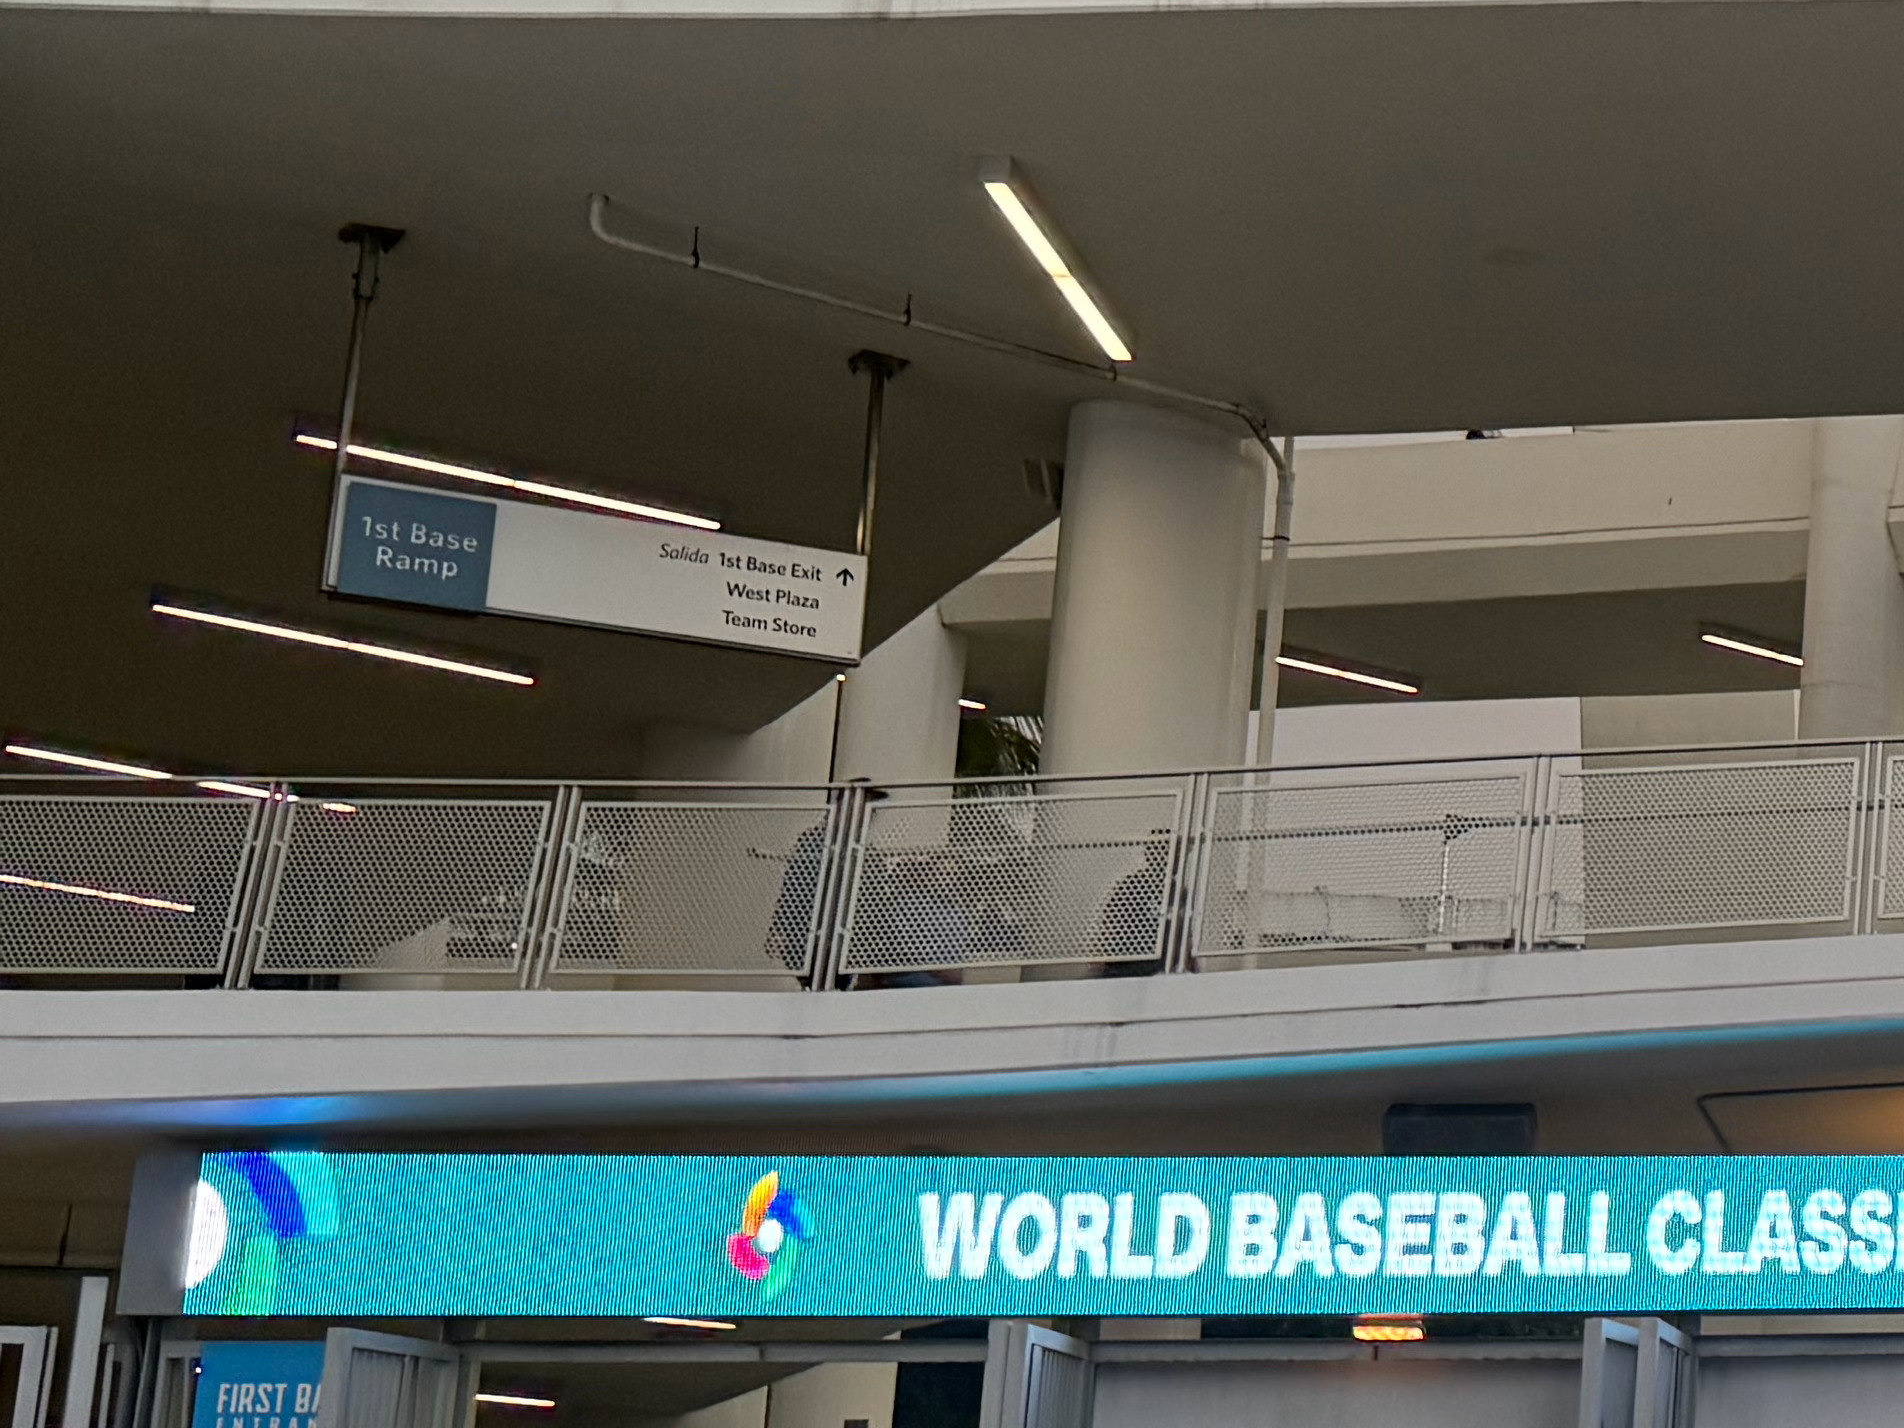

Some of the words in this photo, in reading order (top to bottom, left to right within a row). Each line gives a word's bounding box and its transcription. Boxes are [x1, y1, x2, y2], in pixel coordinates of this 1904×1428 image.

[361, 515, 402, 541] 1st
[409, 522, 479, 555] Base
[375, 545, 459, 580] Ramp
[659, 542, 710, 566] Salida
[718, 551, 743, 572] 1st
[746, 555, 787, 577] Base
[790, 561, 823, 583] Exit
[726, 581, 771, 603] West
[775, 586, 821, 611] Plaza
[722, 609, 768, 633] Team
[772, 615, 818, 639] Store
[917, 1190, 1211, 1279] WORLD
[1226, 1189, 1632, 1278] BASEBALL
[215, 1383, 289, 1414] FIRST
